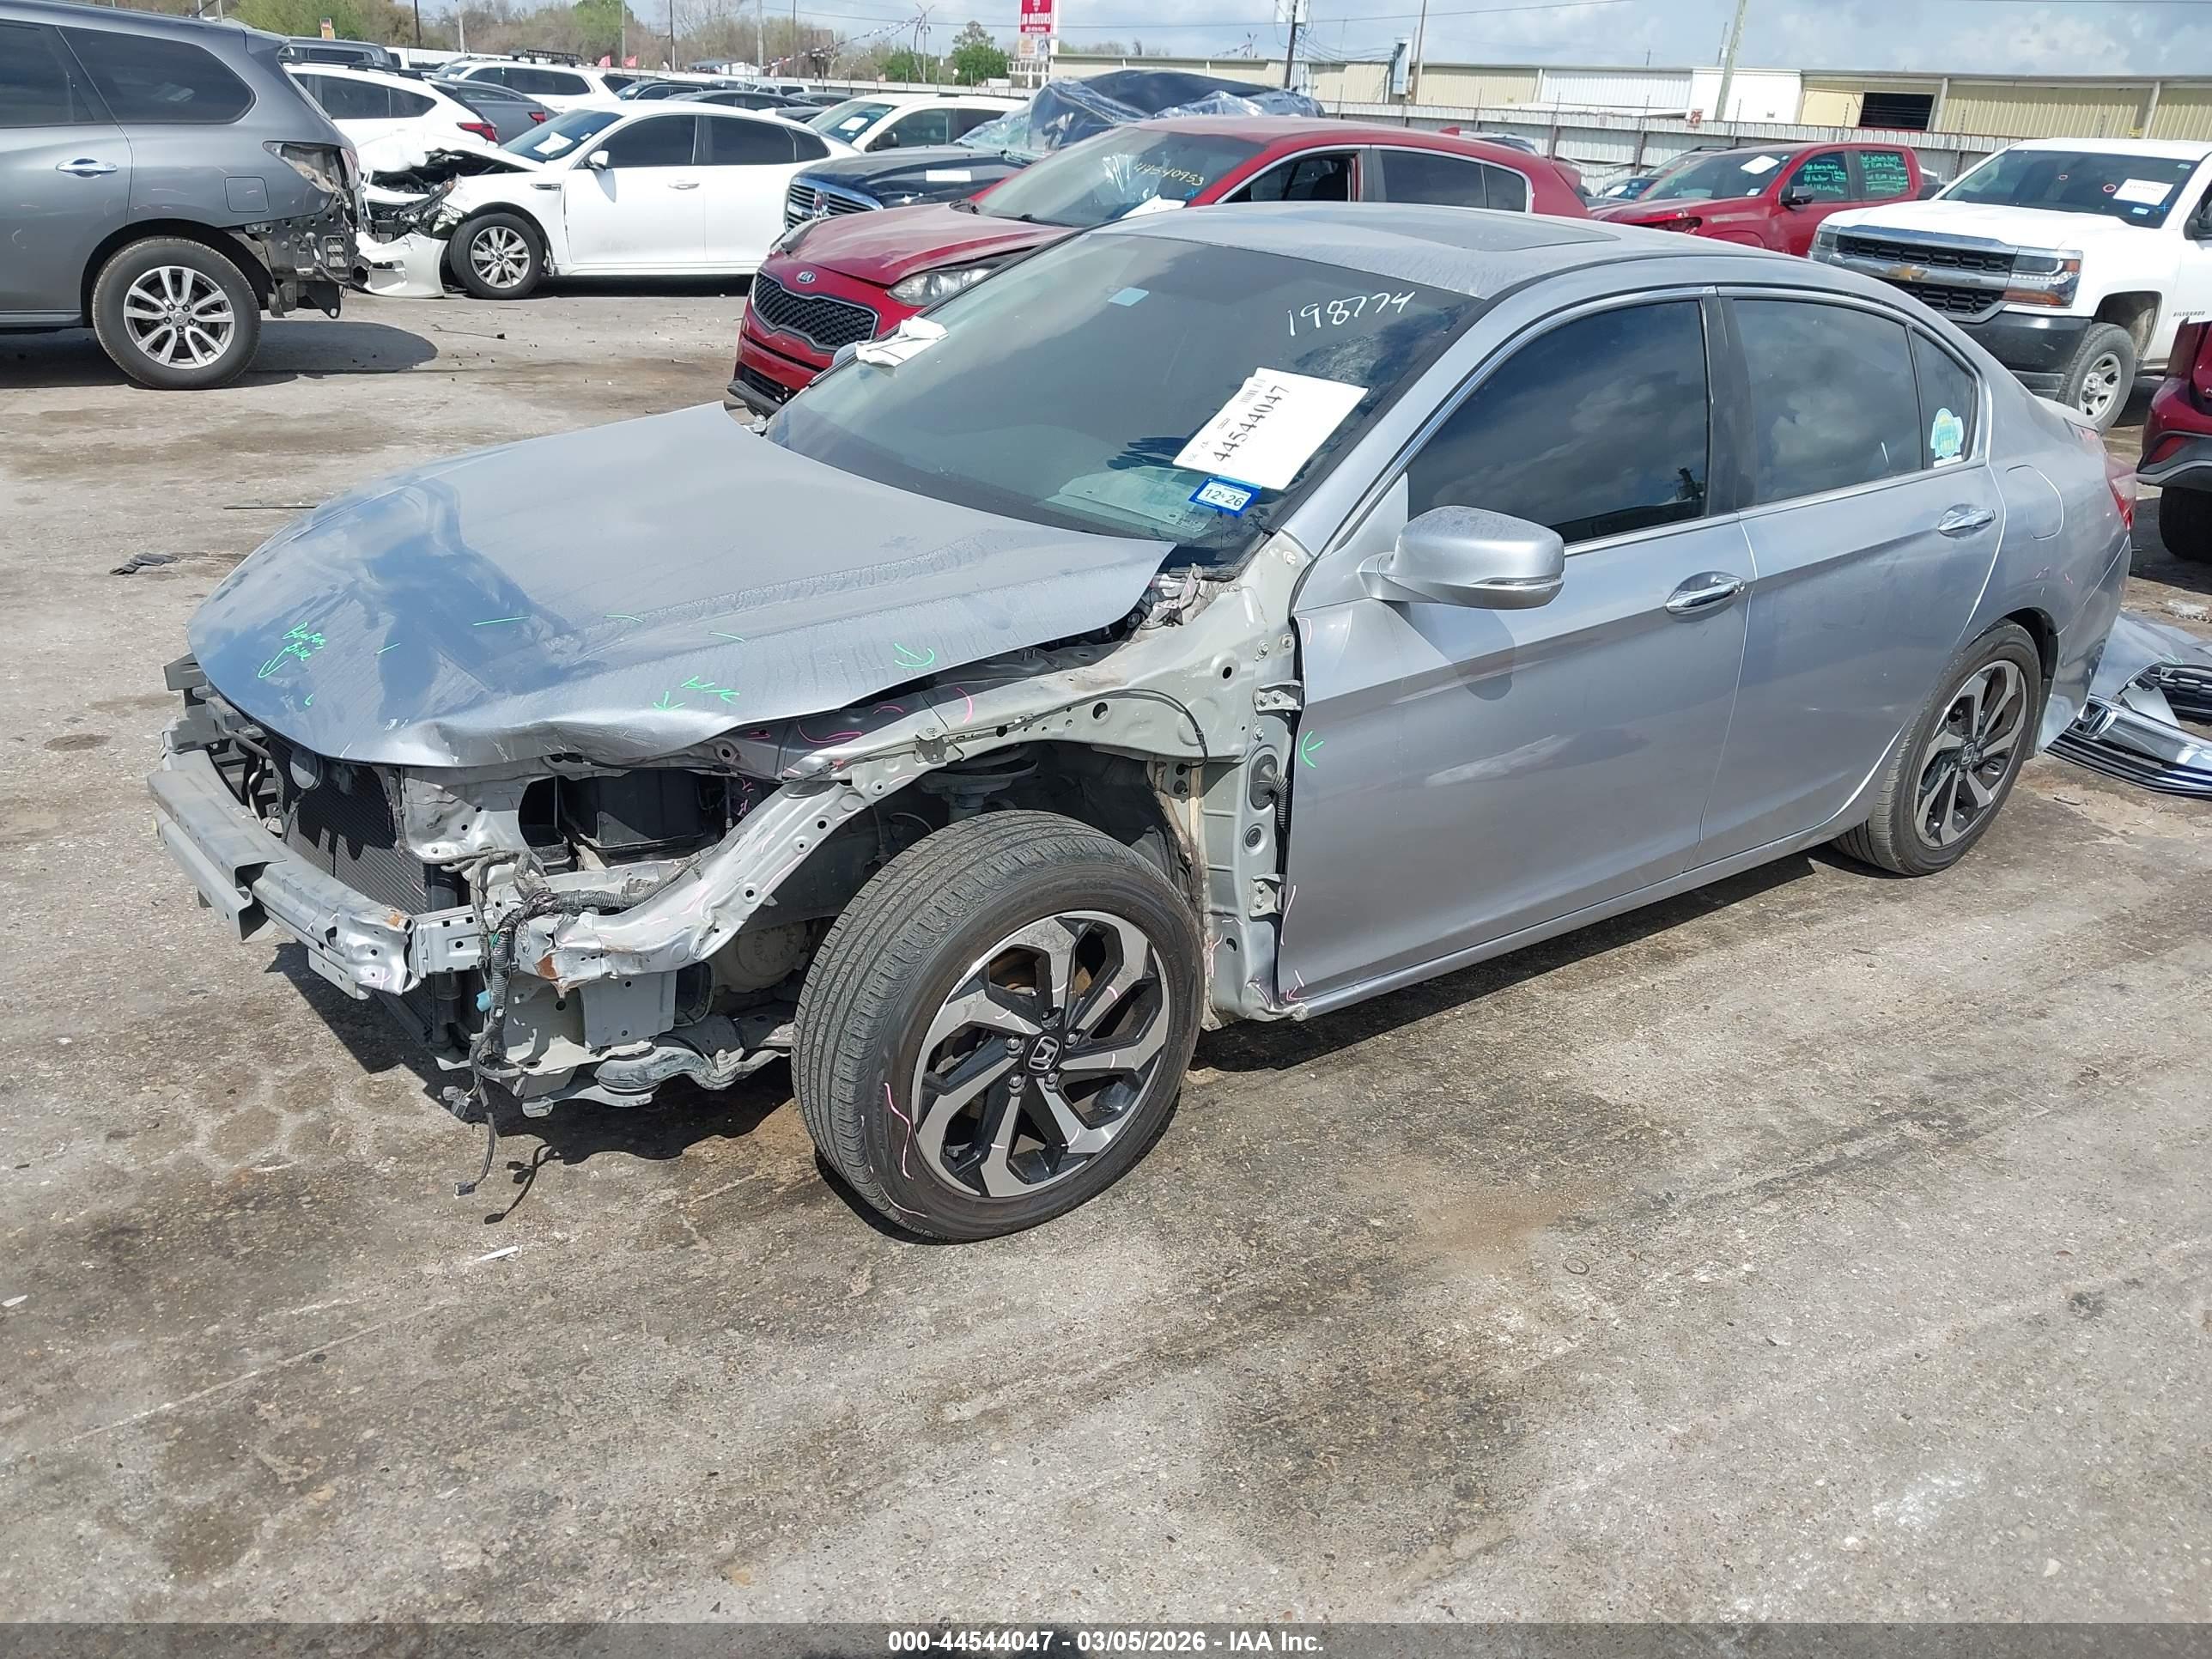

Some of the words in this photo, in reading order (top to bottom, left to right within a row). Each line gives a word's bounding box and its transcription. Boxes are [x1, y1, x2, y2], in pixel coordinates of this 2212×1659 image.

[1690, 110, 1703, 125] 25
[1286, 290, 1416, 337] 198774
[1212, 385, 1291, 462] 44544047
